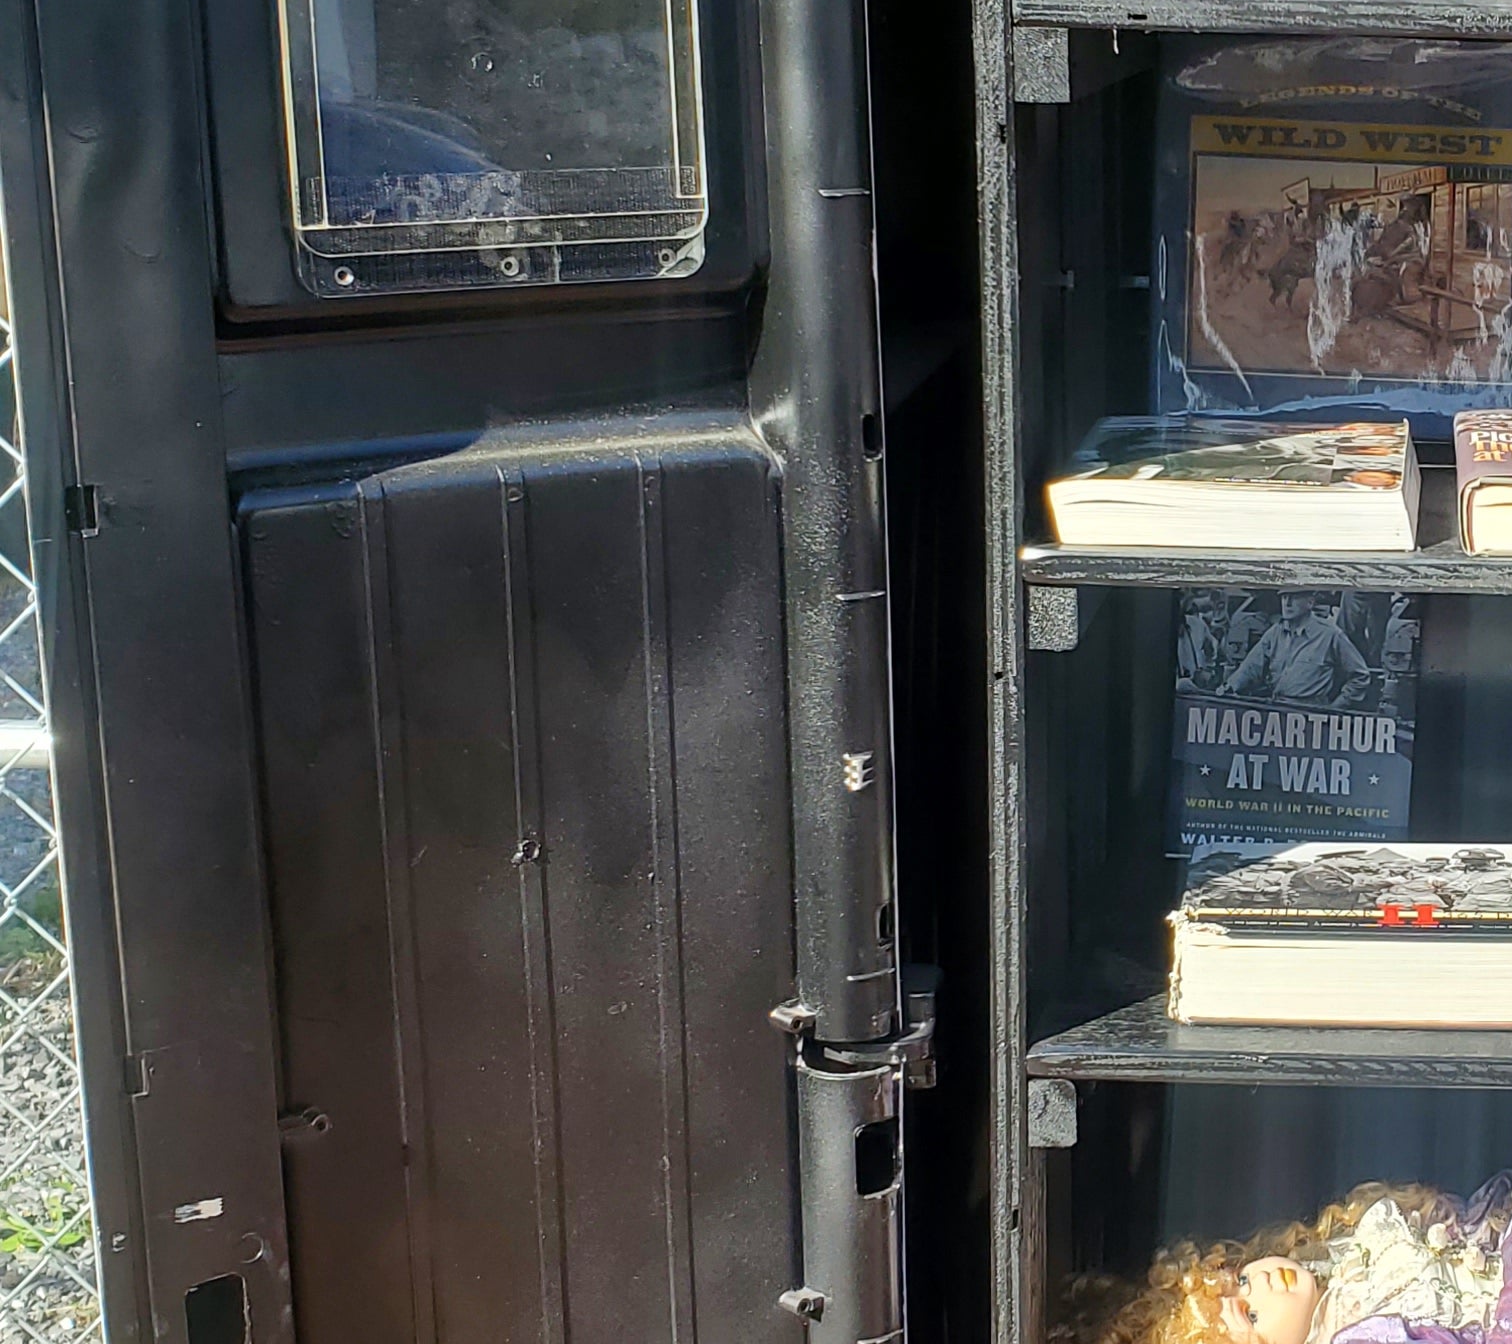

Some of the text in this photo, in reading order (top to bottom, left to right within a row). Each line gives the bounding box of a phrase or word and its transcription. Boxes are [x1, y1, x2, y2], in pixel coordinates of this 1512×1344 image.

[1213, 123, 1503, 157] WILD WEST
[1473, 450, 1505, 463] at
[1187, 707, 1397, 754] MACARTHUR
[1226, 753, 1351, 796] AT WAR
[1186, 797, 1390, 819] WORLD WAR II IN THE PACIFIC
[1377, 903, 1440, 925] II
